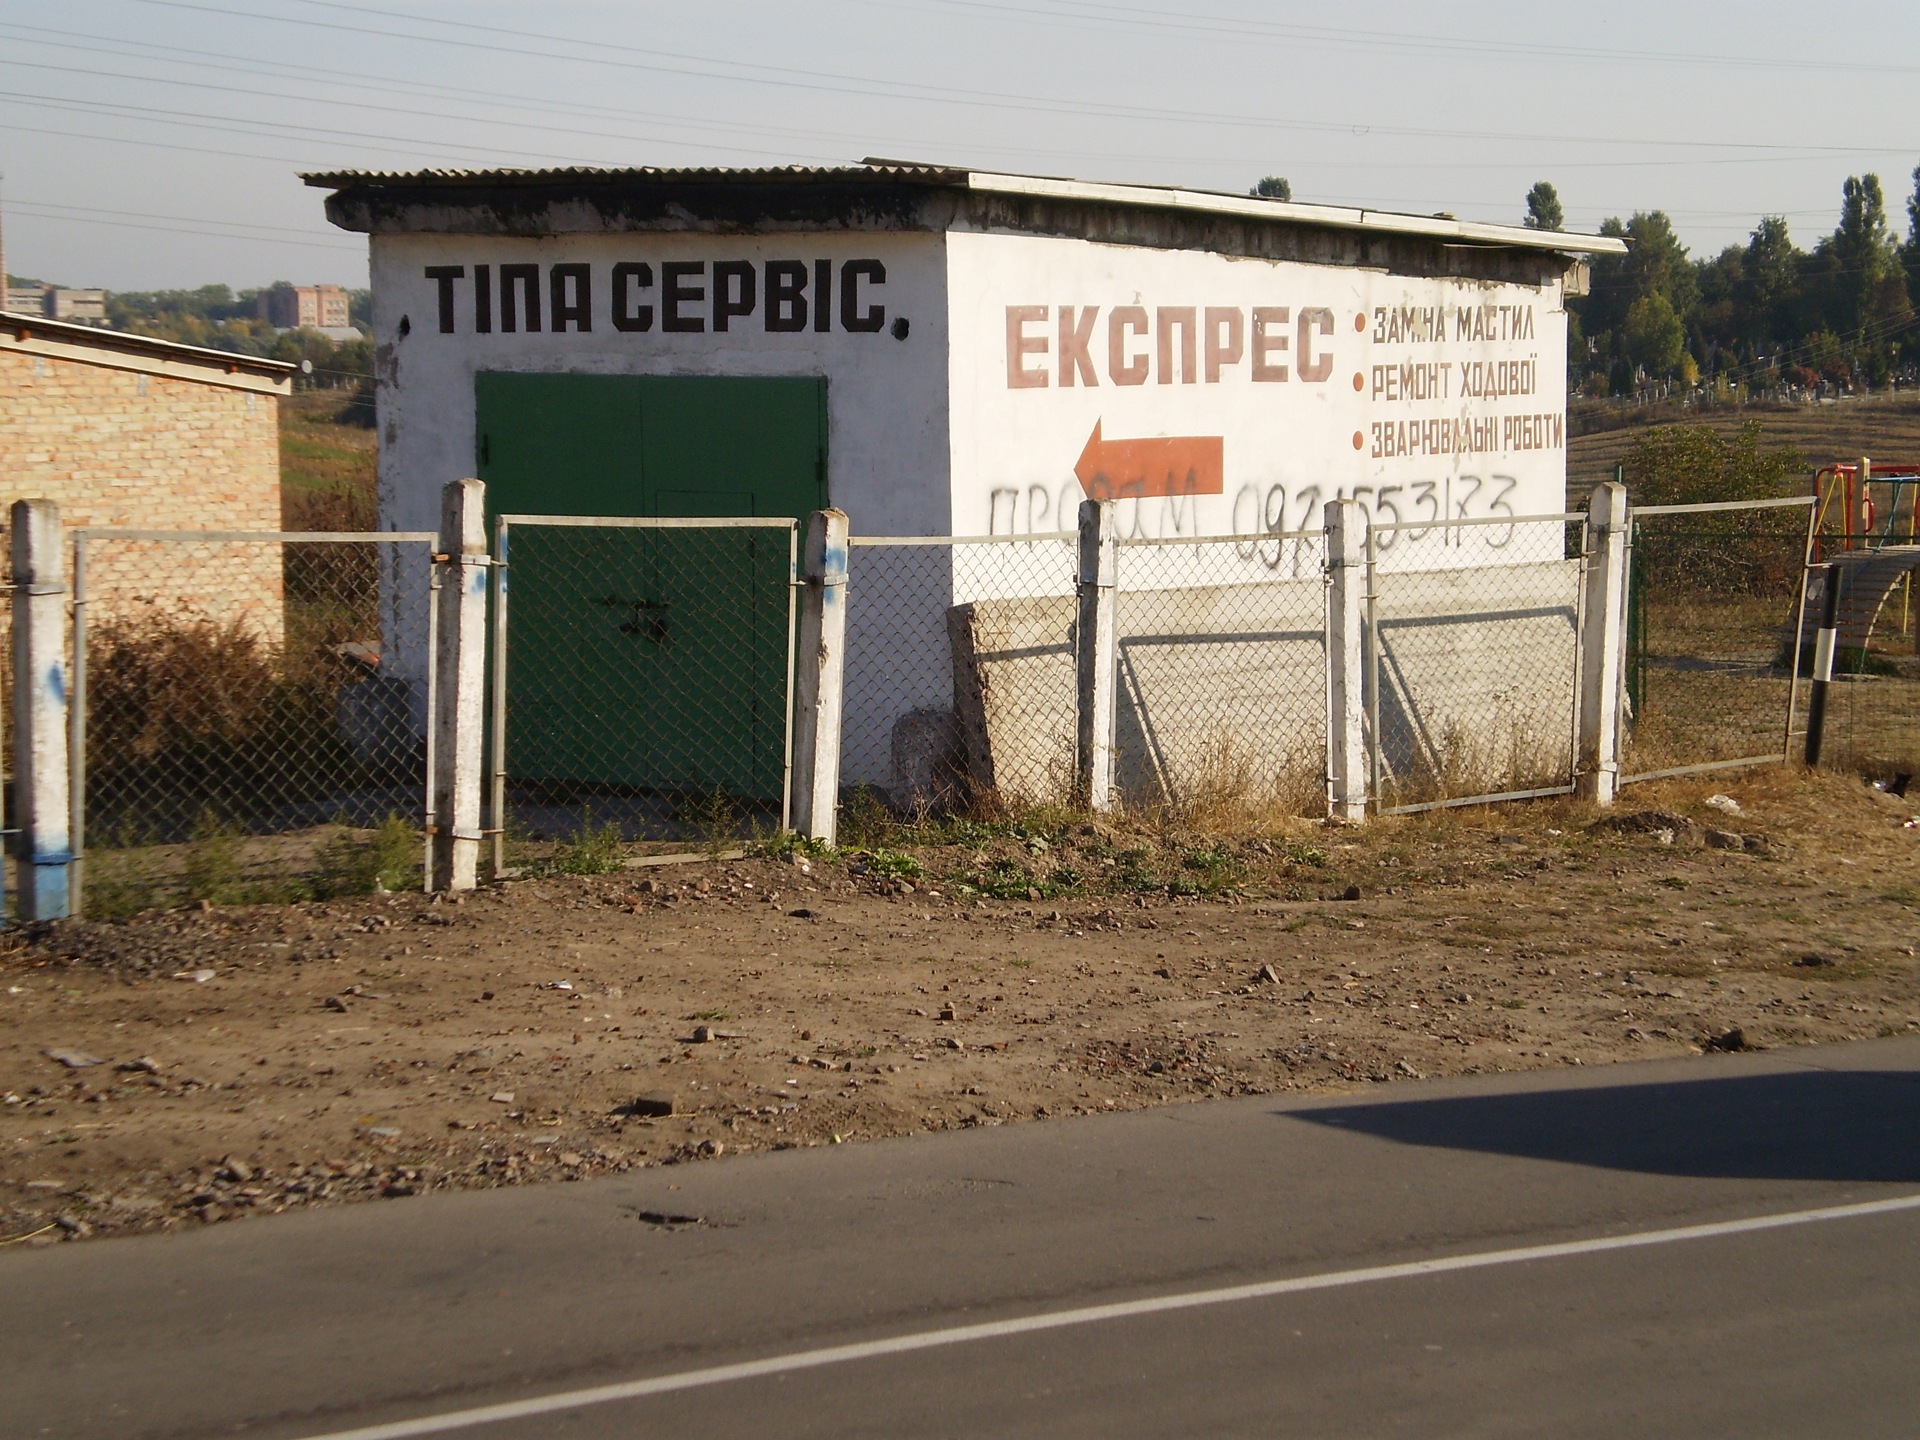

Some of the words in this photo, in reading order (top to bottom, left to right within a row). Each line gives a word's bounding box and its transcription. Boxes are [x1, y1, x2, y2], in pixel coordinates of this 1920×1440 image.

[424, 263, 592, 333] ТІПА
[611, 258, 887, 332] СЕРВІС
[1005, 304, 1335, 389] ЕКСПРЕС
[1456, 304, 1535, 342] МАСТИЛ
[1372, 362, 1452, 402] РЕМОНТ
[1460, 352, 1538, 401] ХОДОВОЇ
[1371, 415, 1499, 459] ЗВАРЮВАЛЬНІ
[1504, 412, 1563, 452] РОБОТИ
